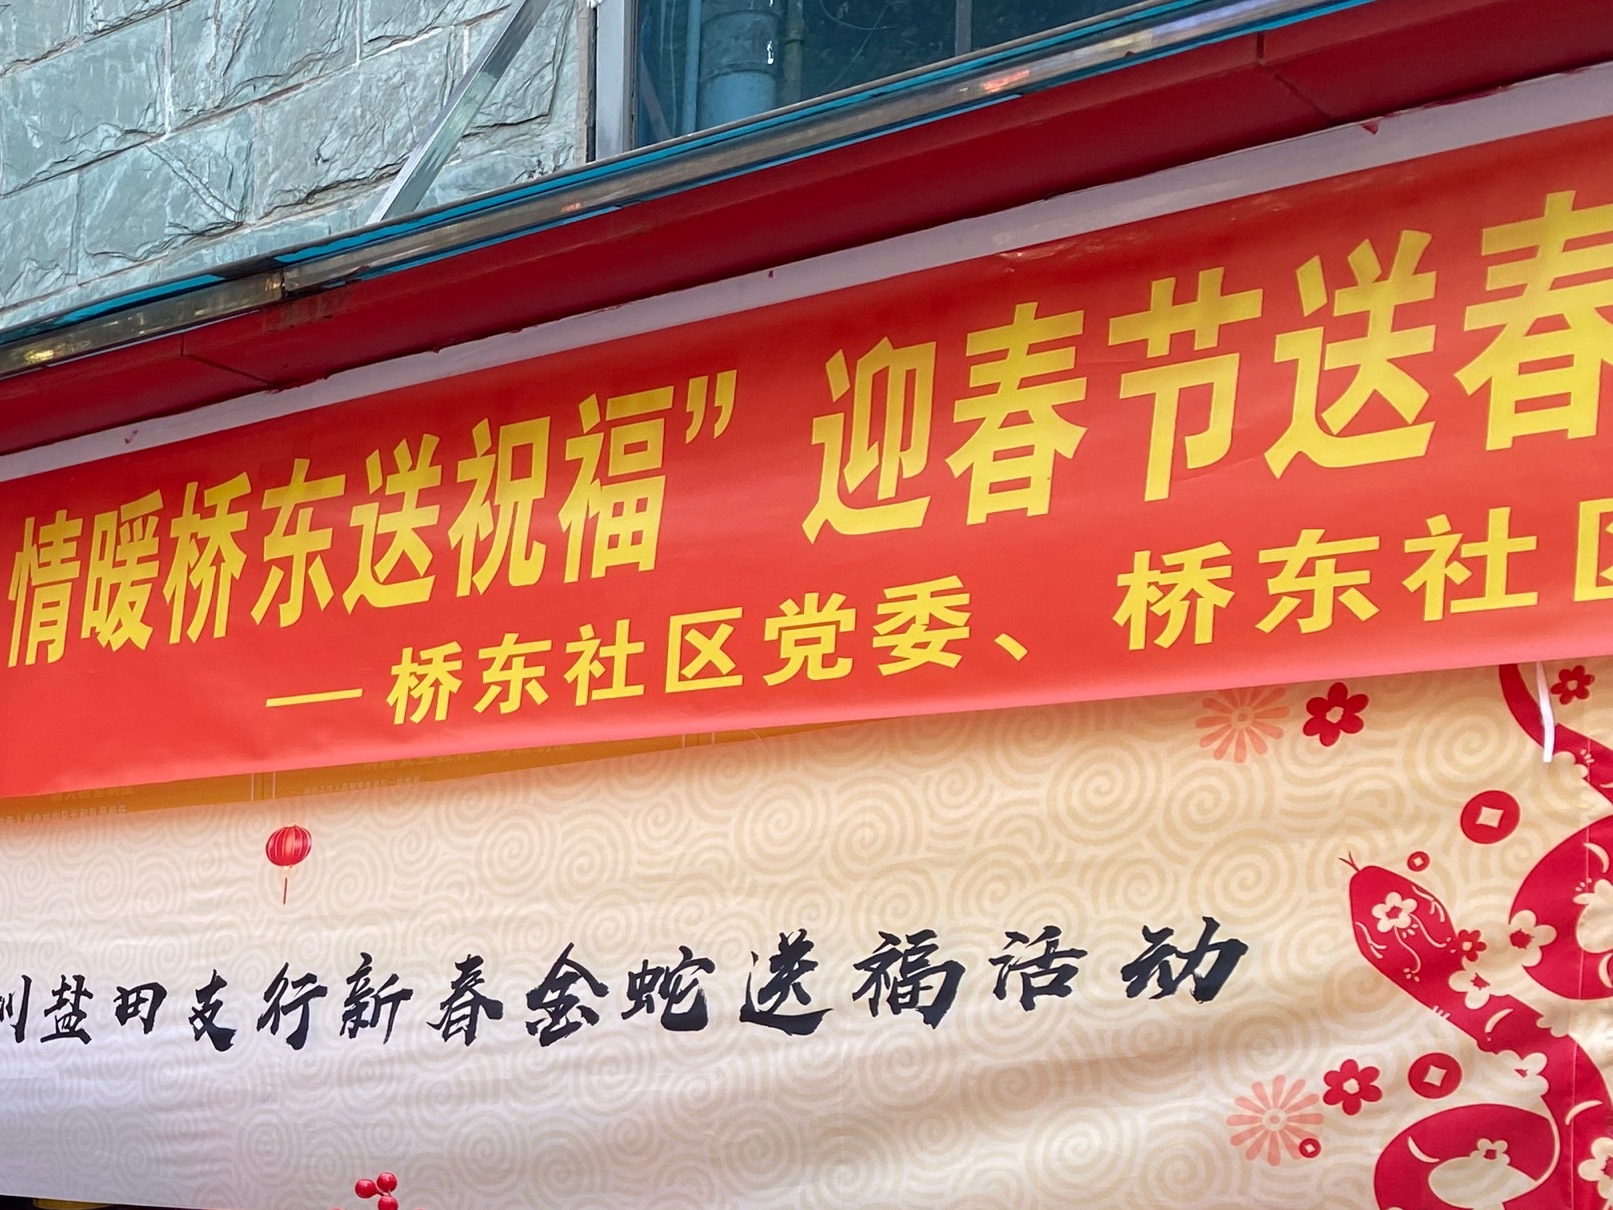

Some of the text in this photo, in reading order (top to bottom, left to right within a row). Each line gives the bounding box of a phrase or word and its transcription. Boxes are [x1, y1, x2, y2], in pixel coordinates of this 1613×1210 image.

[802, 190, 1613, 543] 迎春节送春
[1113, 498, 1613, 650] 桥东社
